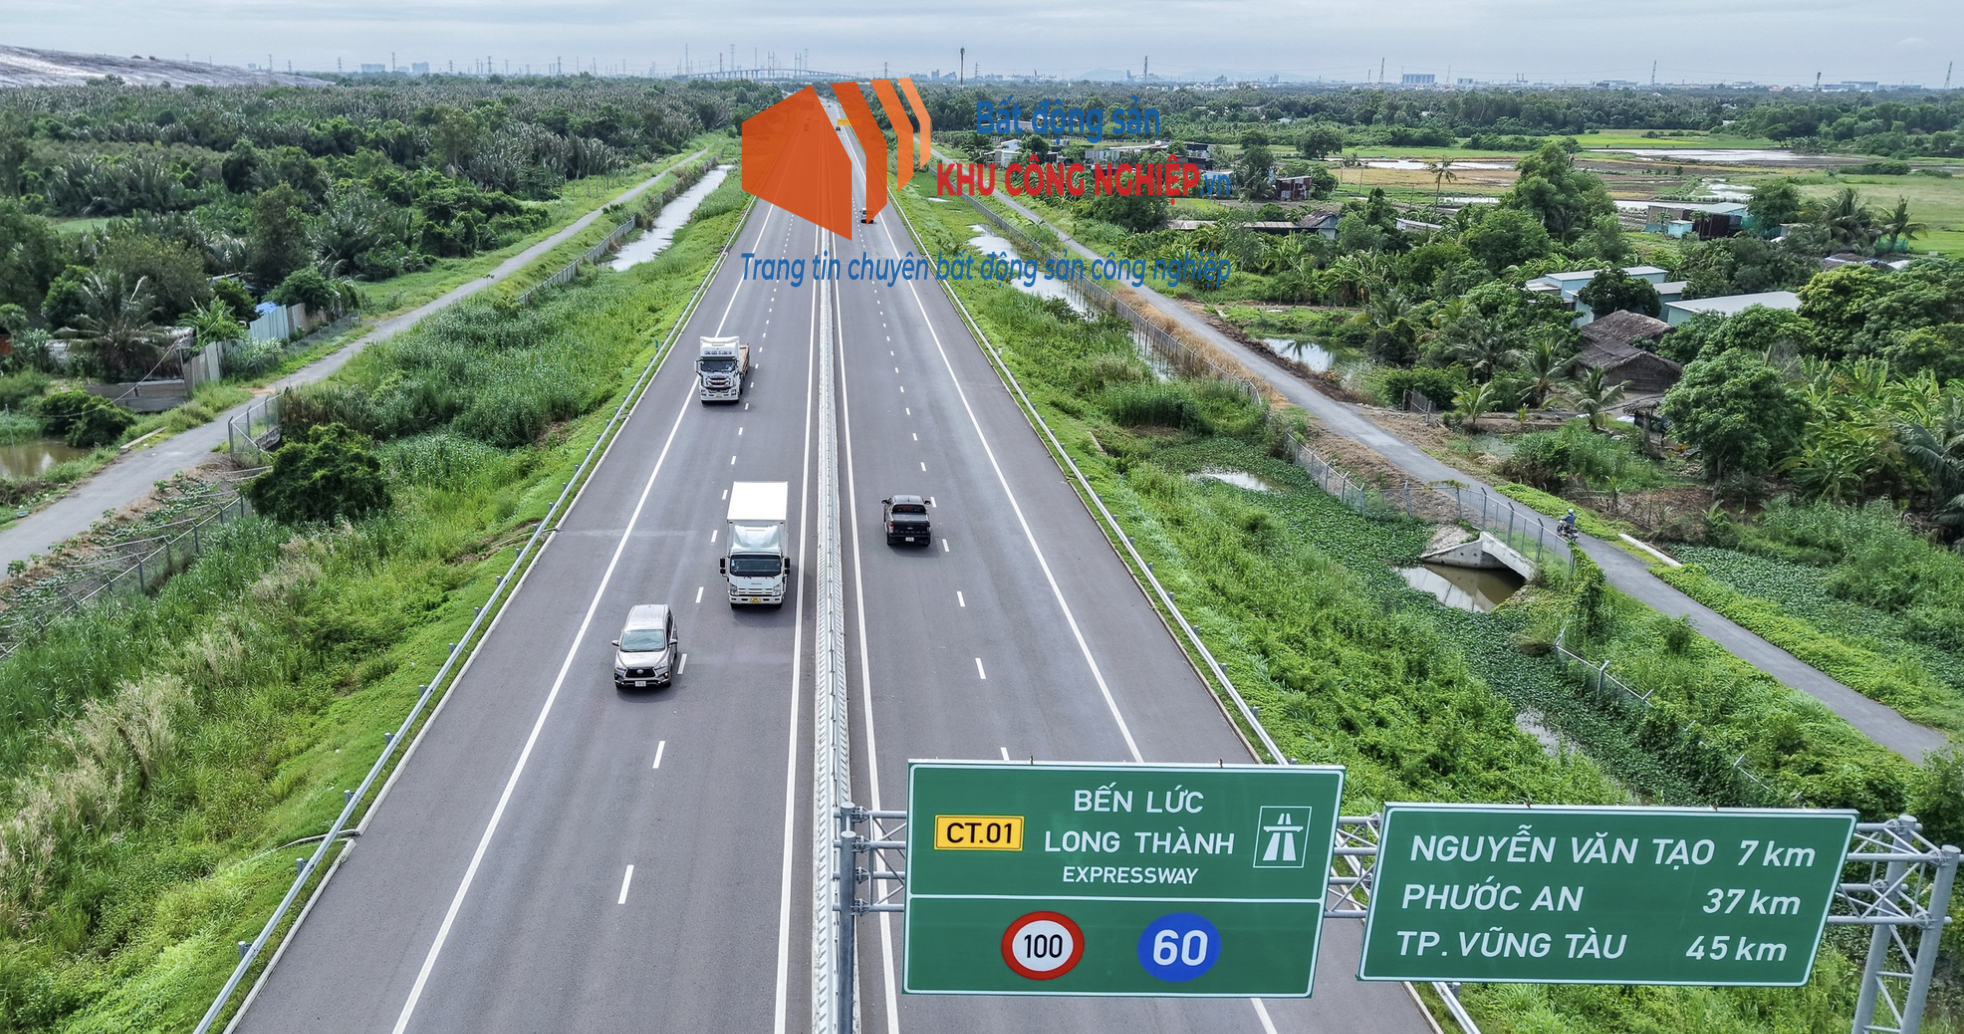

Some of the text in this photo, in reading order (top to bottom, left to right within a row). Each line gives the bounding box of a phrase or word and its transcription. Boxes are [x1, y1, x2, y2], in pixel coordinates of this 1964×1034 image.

[1074, 782, 1204, 814] BẾN LỨC
[946, 822, 1013, 844] CT.01
[1045, 826, 1235, 855] LONG THÀNH
[1410, 824, 1816, 870] NGUYỄN VĂN TẠO 7 km
[1062, 866, 1199, 885] EXPRESSWAY
[1402, 875, 1801, 915] PHƯỚC AN 37 km
[1023, 934, 1063, 959] 100
[1152, 929, 1208, 966] 60
[1397, 926, 1787, 961] TP. VŨNG TÀU 45 km
